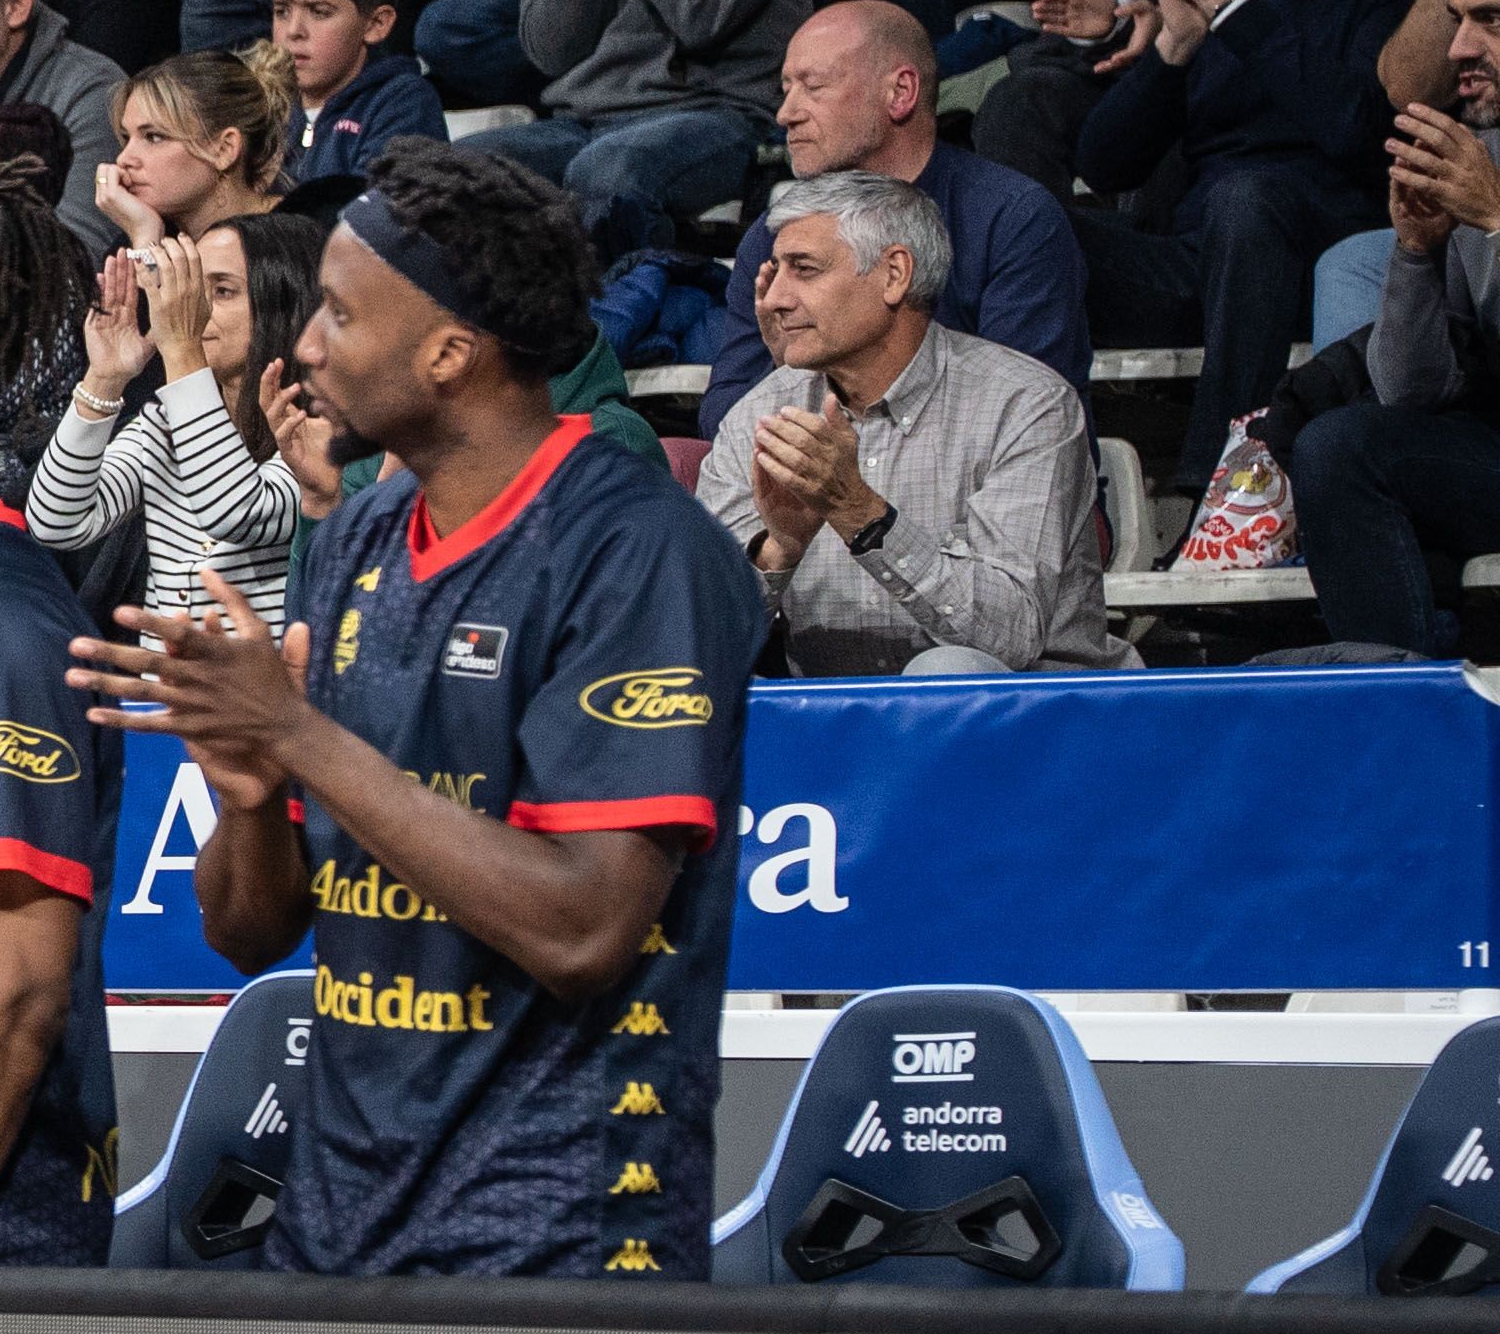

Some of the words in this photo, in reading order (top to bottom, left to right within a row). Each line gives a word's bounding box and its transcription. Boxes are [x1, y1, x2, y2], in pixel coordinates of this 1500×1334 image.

[1458, 941, 1490, 968] 11
[315, 961, 495, 1031] Occident
[893, 1041, 976, 1075] OMP
[902, 1103, 1002, 1125] andorra
[902, 1128, 1007, 1153] telecom
